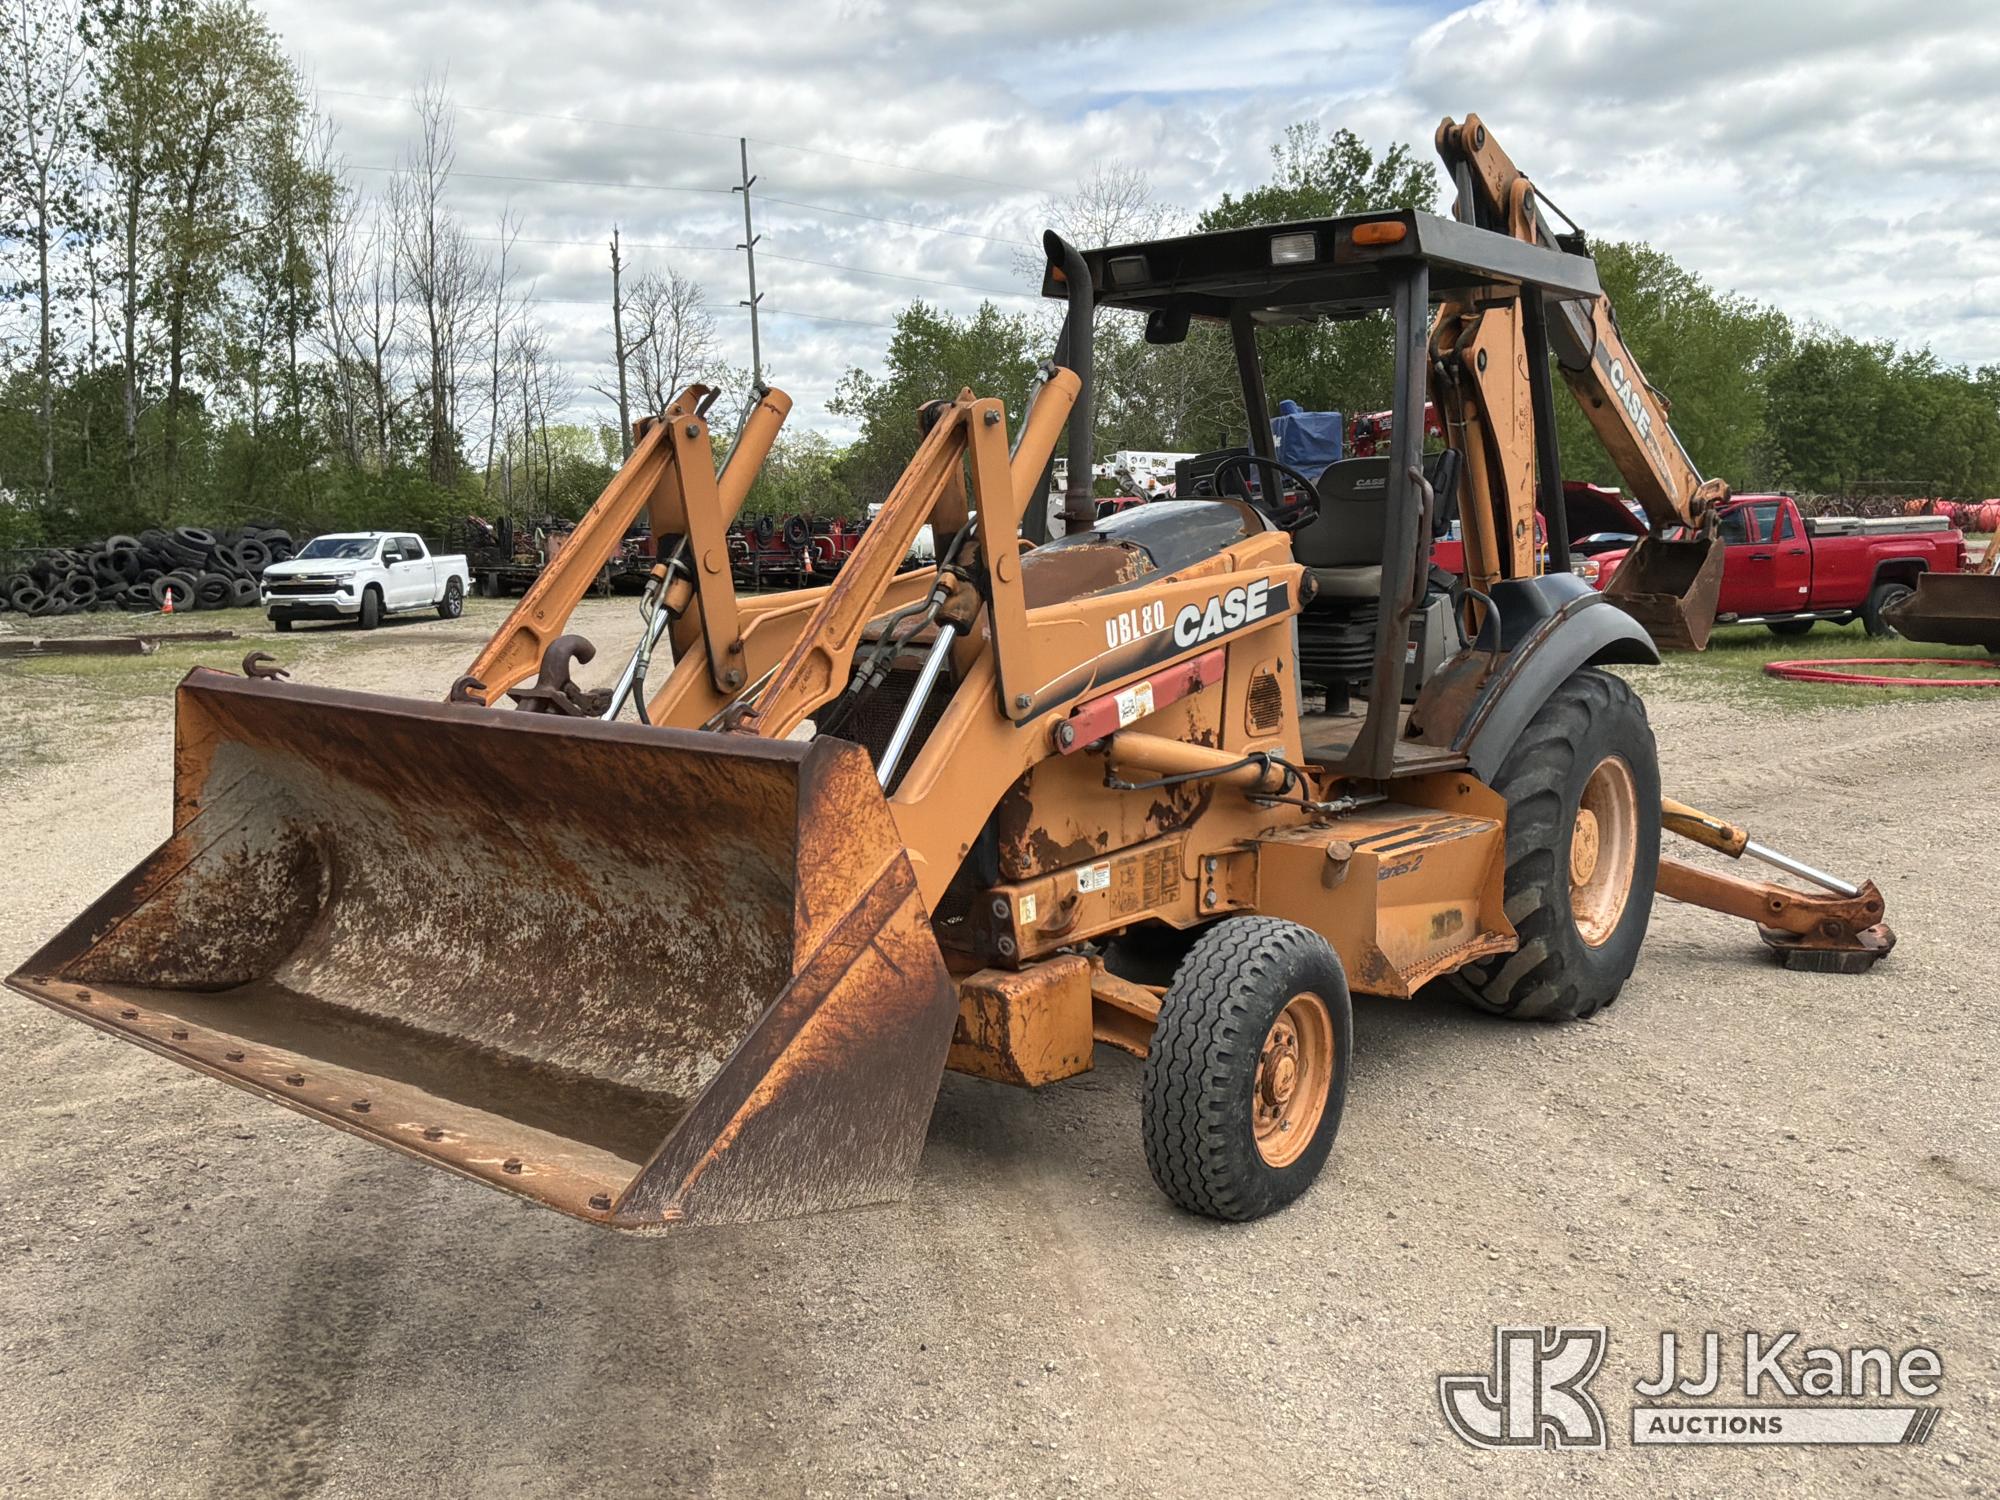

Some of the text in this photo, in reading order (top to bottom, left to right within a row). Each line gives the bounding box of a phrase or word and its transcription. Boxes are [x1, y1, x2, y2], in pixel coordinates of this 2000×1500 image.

[1610, 358, 1651, 439] CASE
[1356, 478, 1385, 487] CASE
[1173, 577, 1270, 648] CASE
